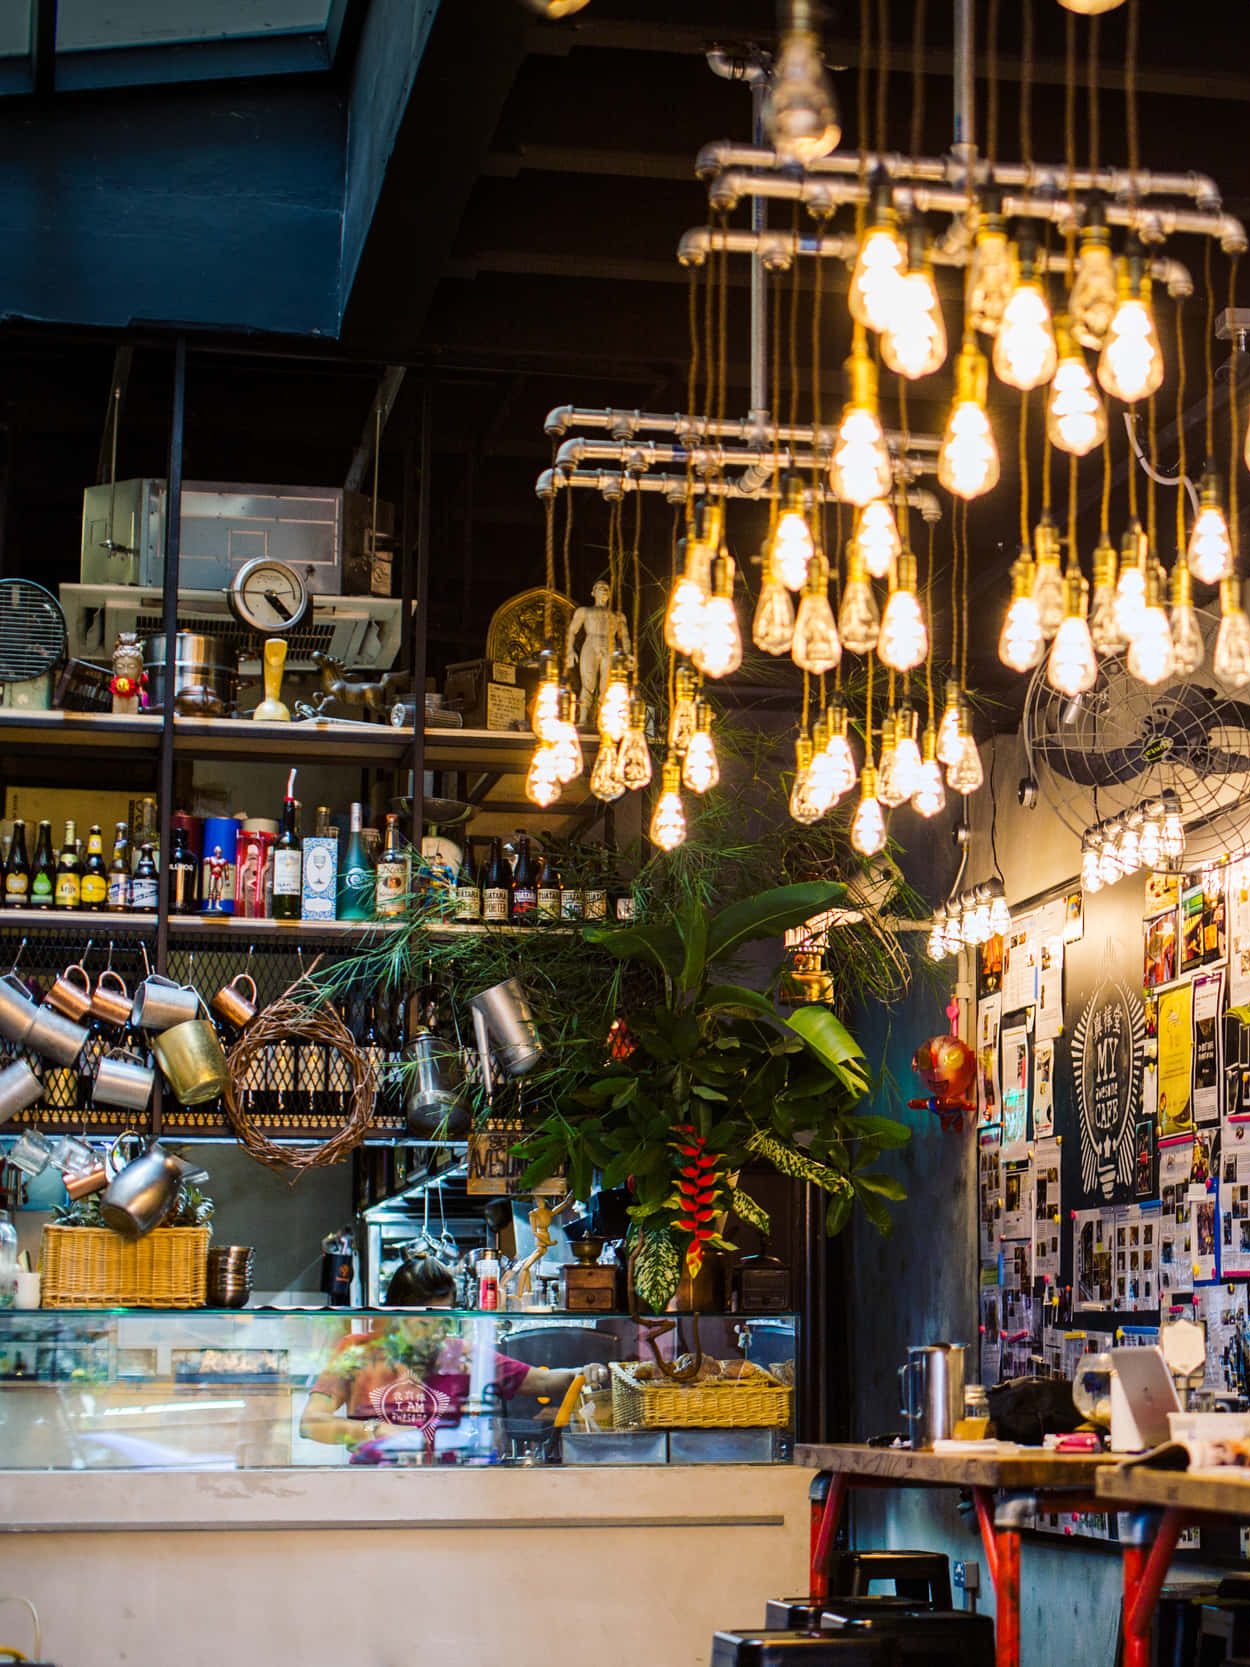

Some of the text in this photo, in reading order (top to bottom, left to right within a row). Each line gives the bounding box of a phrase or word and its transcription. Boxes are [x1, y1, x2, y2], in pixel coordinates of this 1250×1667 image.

[1096, 1037, 1119, 1083] MY
[395, 1401, 425, 1413] I AM
